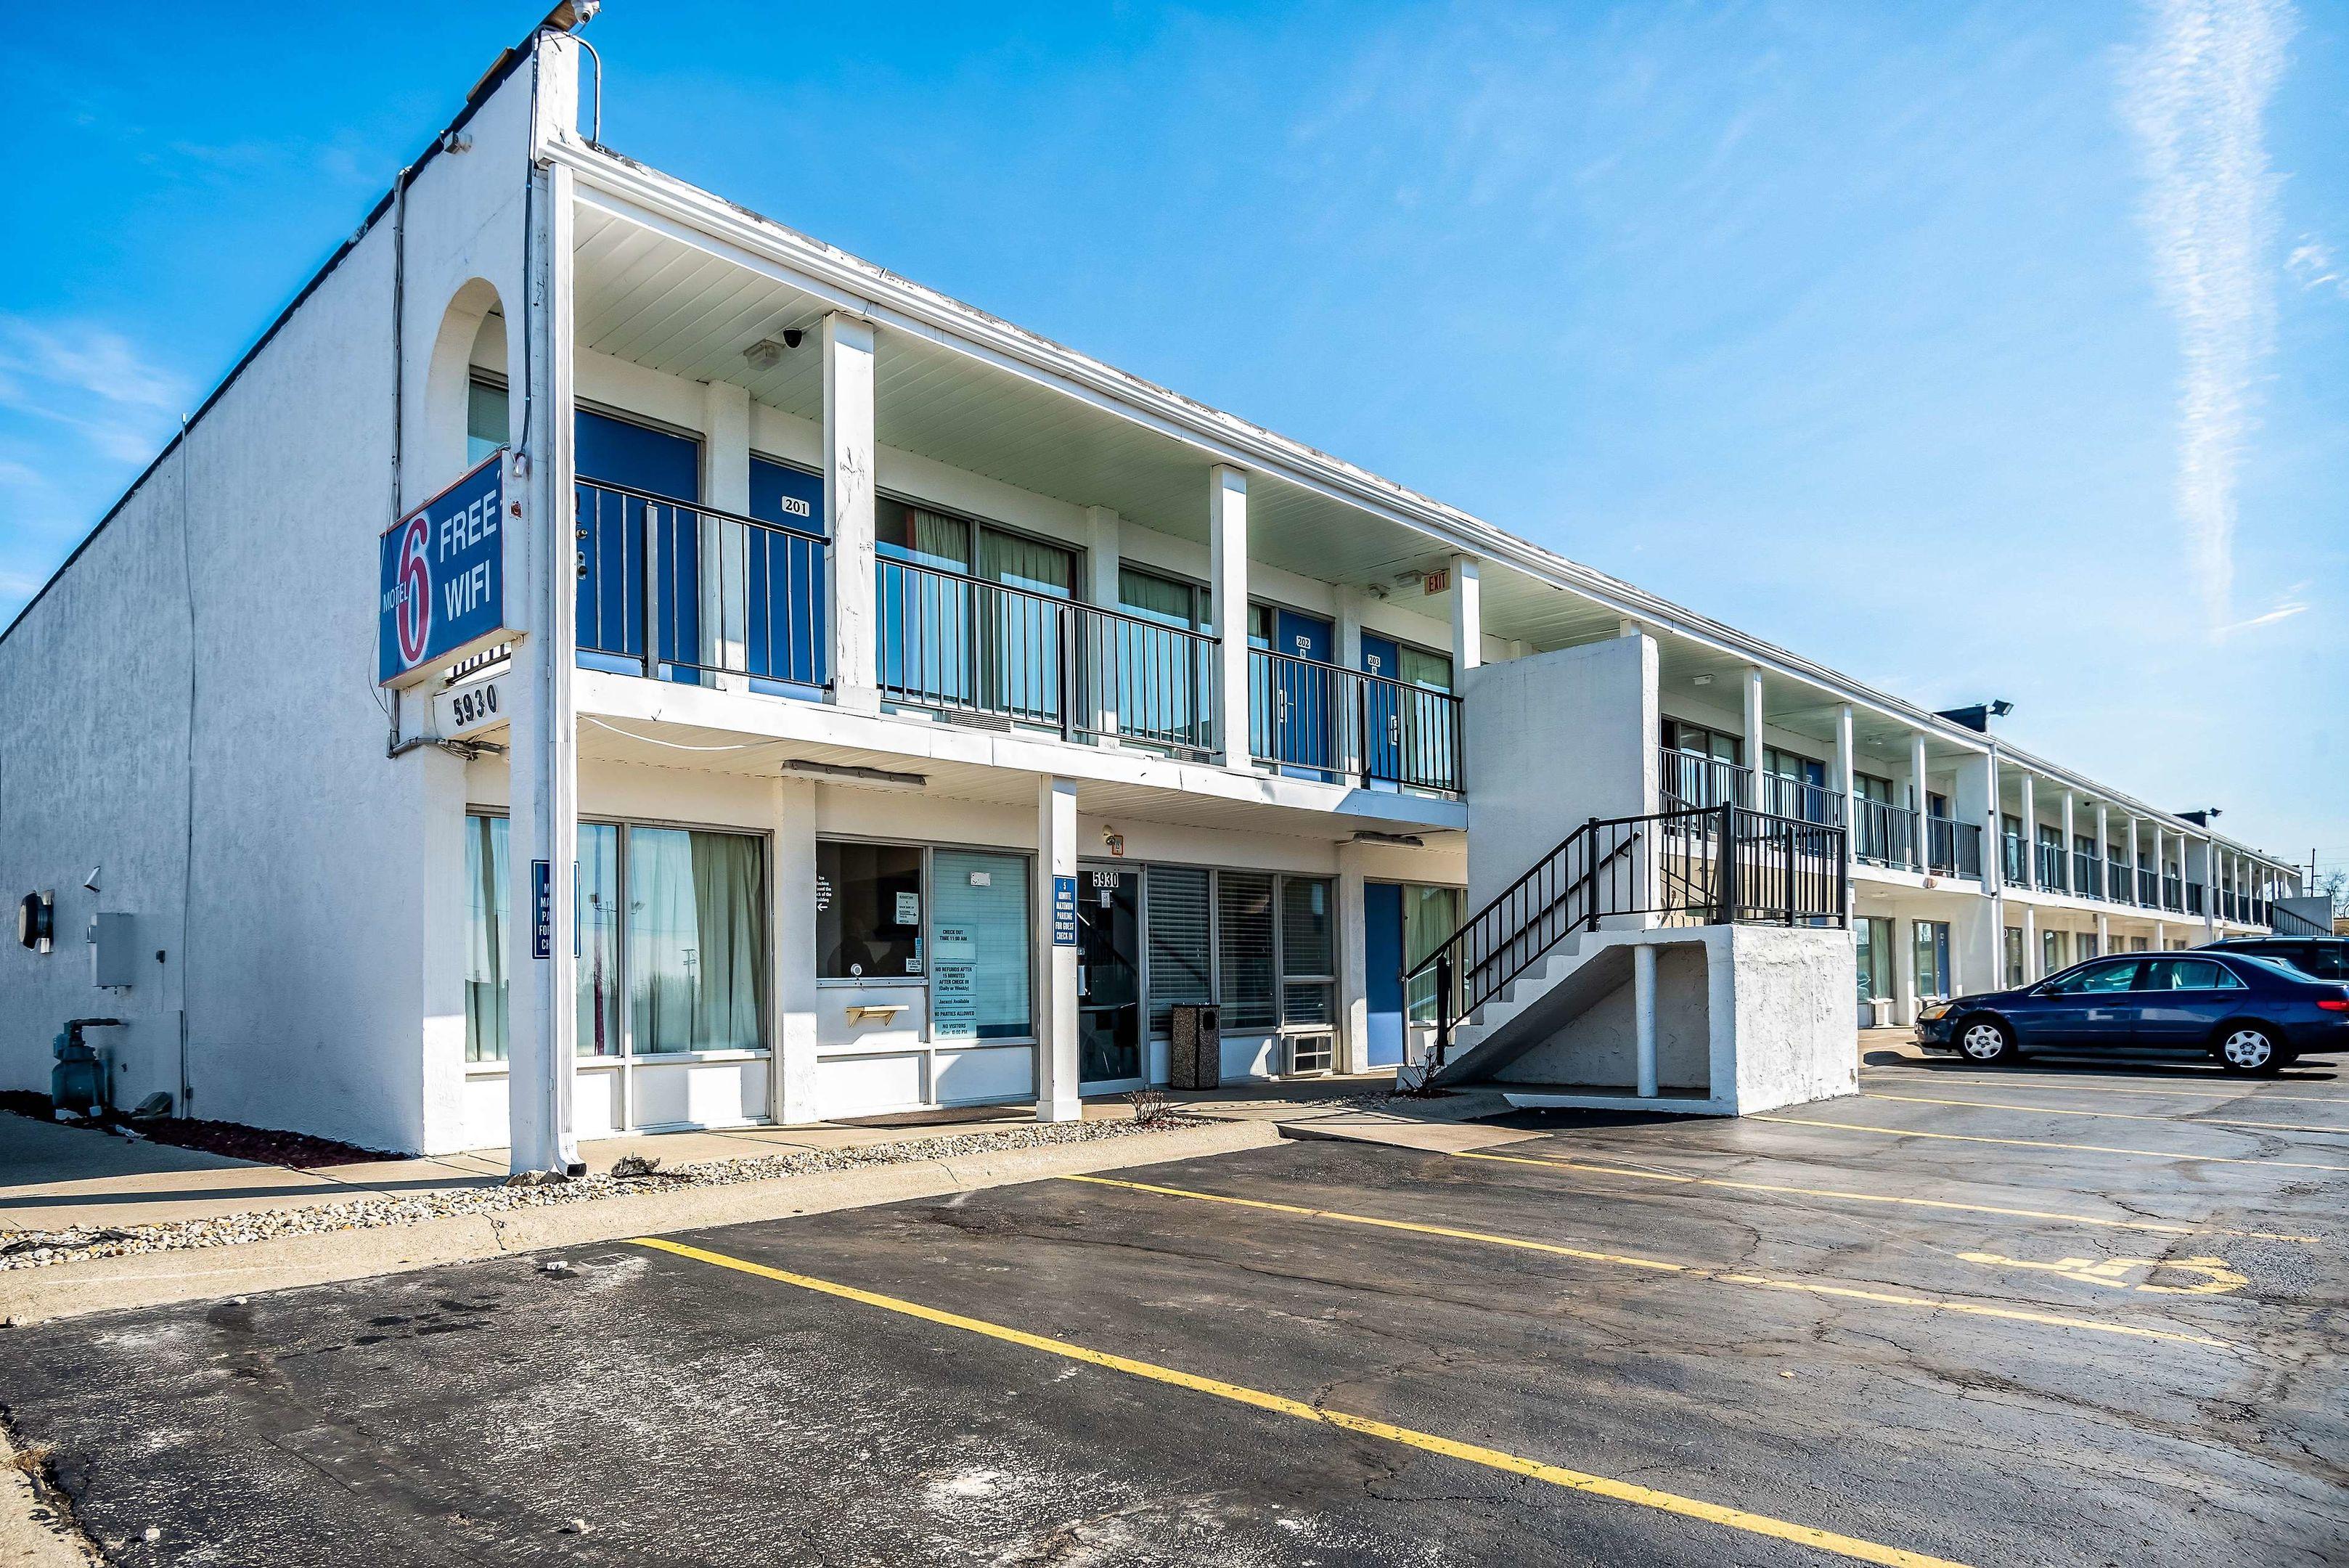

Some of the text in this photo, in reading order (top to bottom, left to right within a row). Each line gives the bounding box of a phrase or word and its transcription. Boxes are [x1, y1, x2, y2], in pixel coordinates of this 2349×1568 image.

[785, 499, 806, 515] 201
[440, 489, 497, 563] FREE
[383, 514, 432, 666] MOTEL 6
[444, 559, 490, 621] WIFI
[1429, 573, 1446, 592] EXIT
[1297, 637, 1310, 648] 202
[1368, 656, 1380, 666] 203
[453, 684, 497, 727] 5930
[1063, 881, 1066, 890] 5
[1093, 872, 1119, 887] 5930
[1057, 911, 1073, 920] PARKING
[1063, 922, 1074, 931] GUEST
[1056, 931, 1069, 940] CHECK
